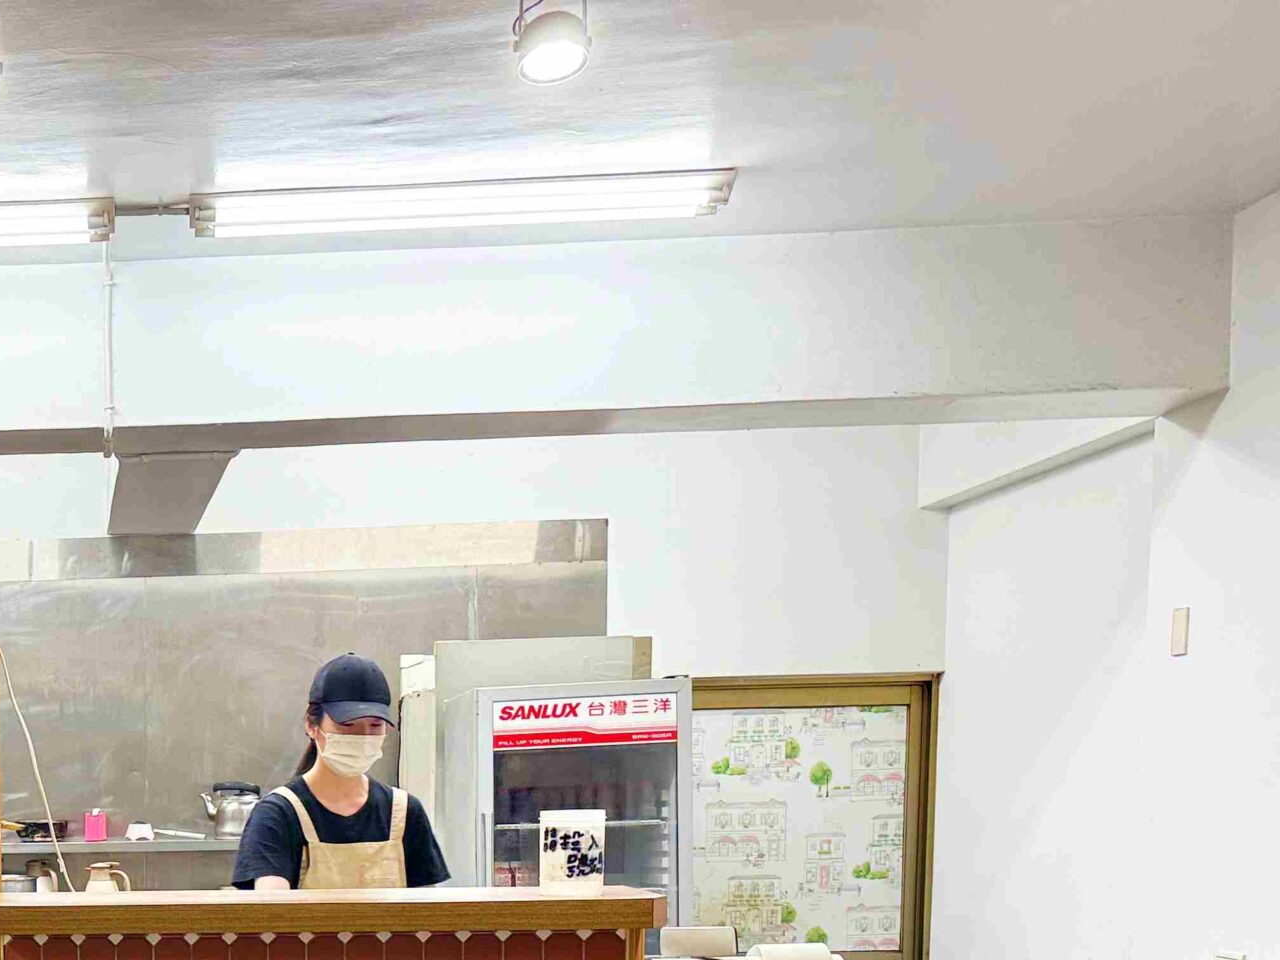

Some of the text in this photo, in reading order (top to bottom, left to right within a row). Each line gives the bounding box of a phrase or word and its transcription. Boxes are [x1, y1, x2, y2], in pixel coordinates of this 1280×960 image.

[499, 698, 672, 721] SANLUX 台灣三洋
